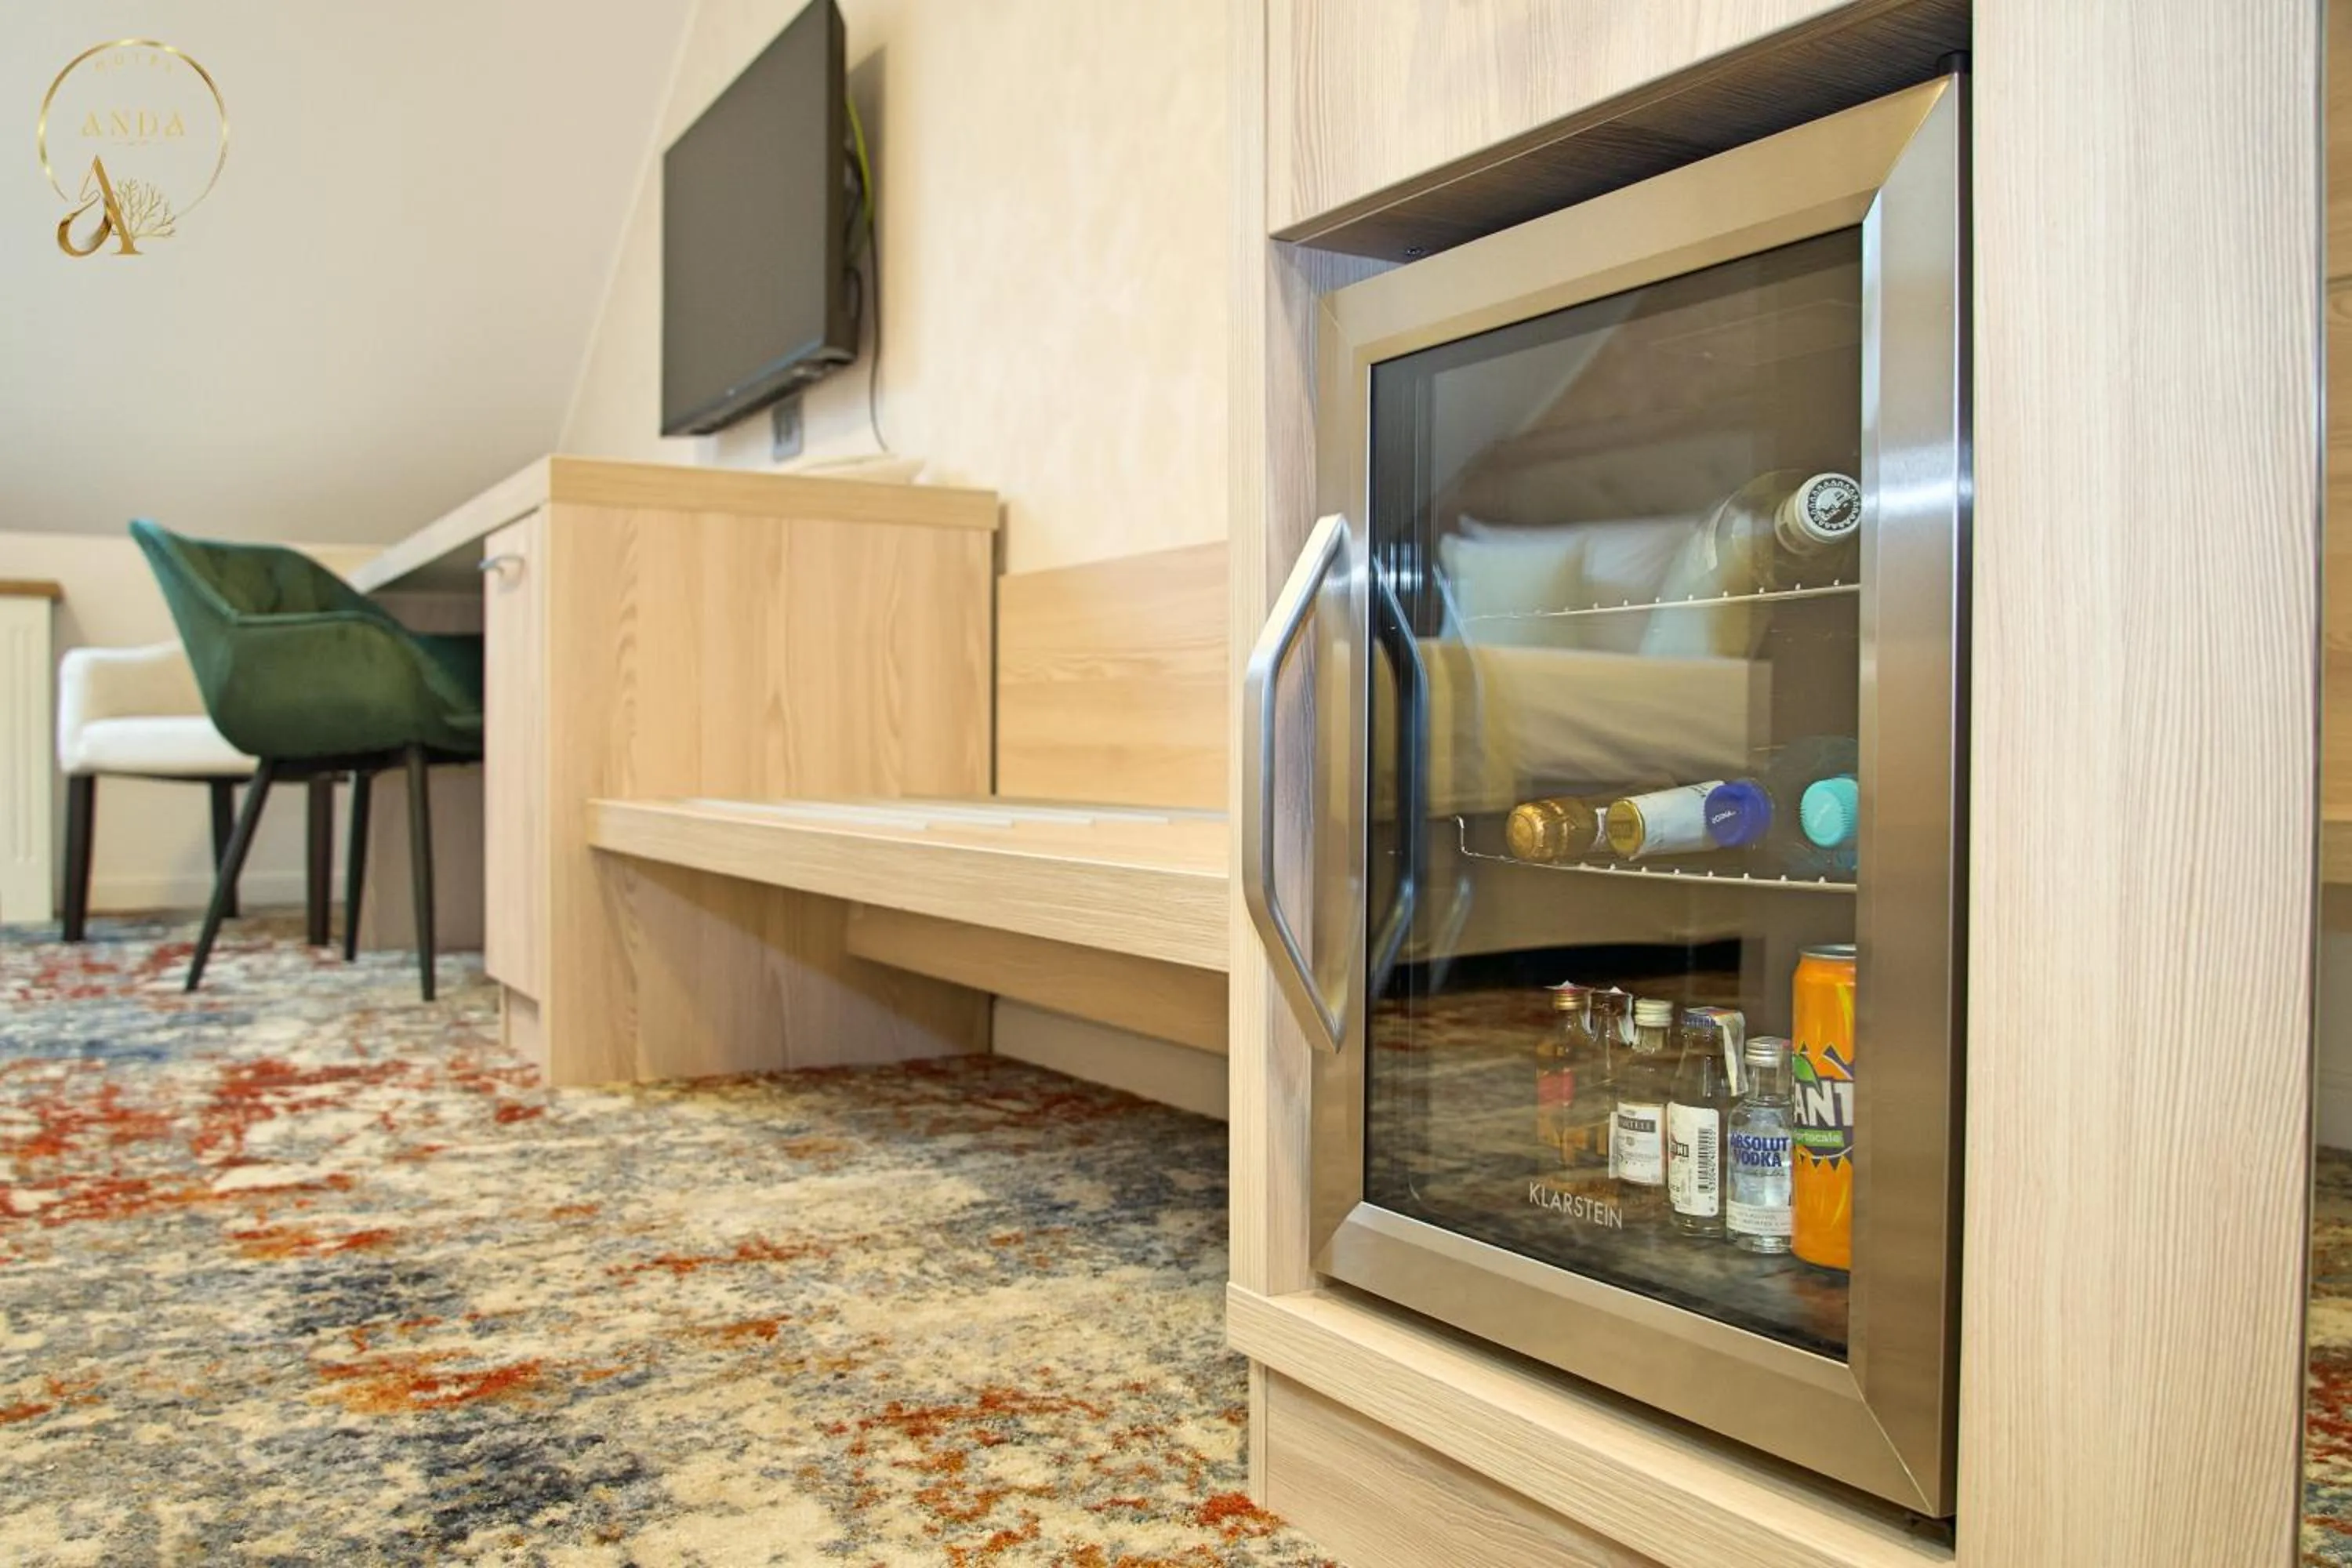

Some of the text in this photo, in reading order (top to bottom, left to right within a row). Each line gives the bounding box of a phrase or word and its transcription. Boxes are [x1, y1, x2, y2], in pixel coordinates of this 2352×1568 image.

[1793, 1080, 1854, 1127] ANT
[1730, 1131, 1789, 1152] ABSOLUT
[1733, 1149, 1782, 1167] VODKA
[1530, 1181, 1622, 1230] KLARSTEIN
